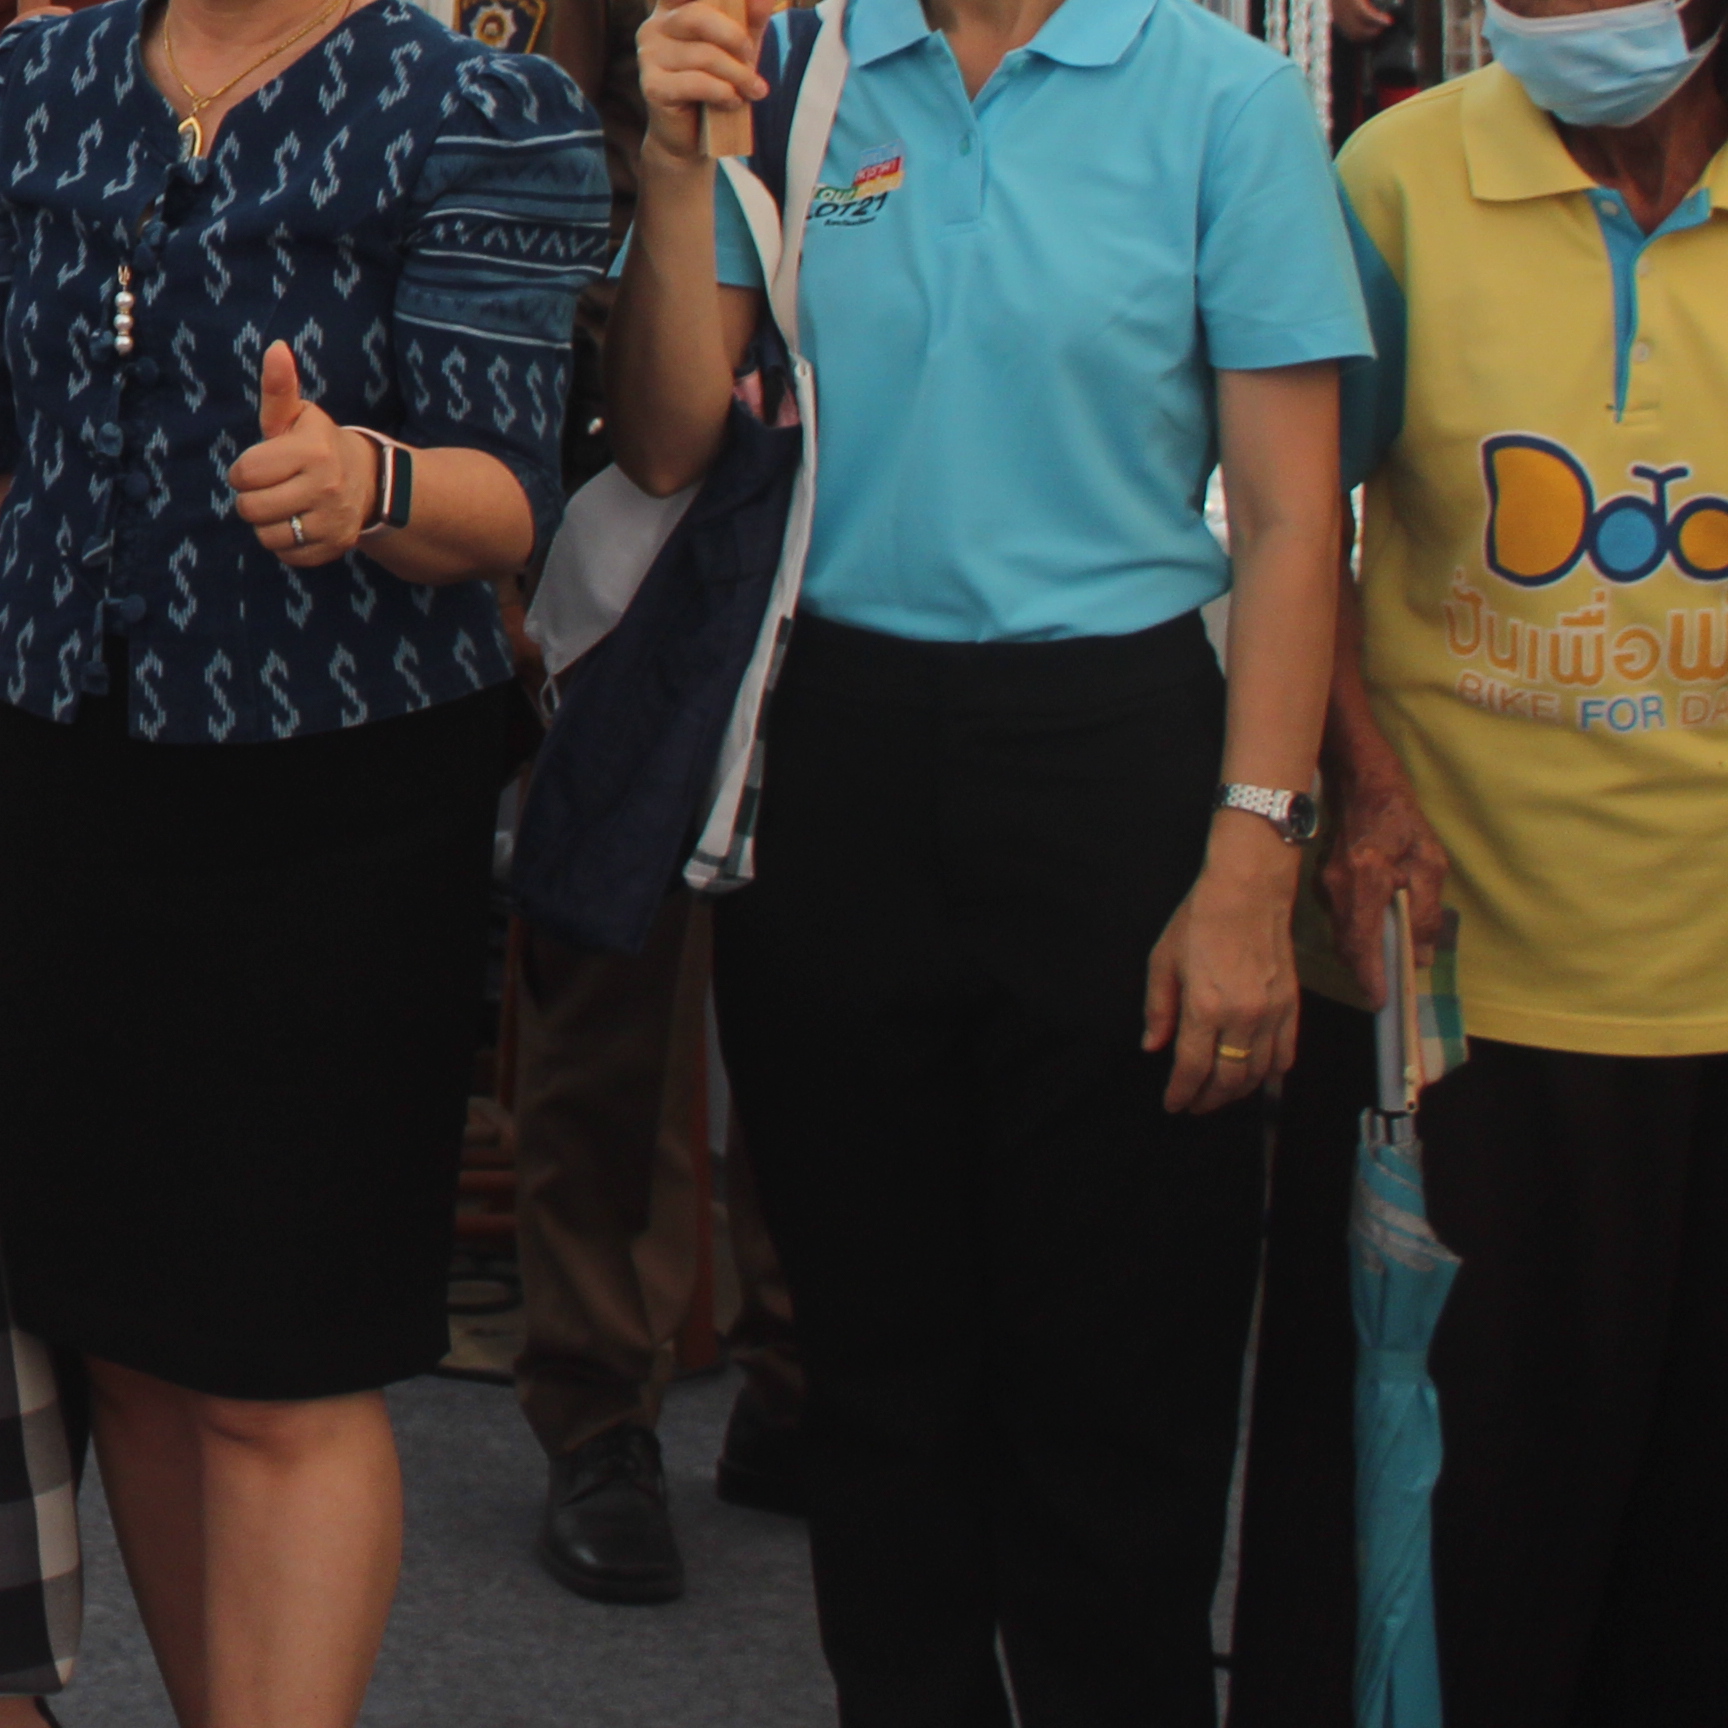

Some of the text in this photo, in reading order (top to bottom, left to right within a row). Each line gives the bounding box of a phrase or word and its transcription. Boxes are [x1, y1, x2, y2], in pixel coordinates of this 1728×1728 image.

[806, 192, 888, 220] OT21
[1444, 568, 1728, 687] ปั่นเพื่อพ
[1456, 672, 1560, 721] BIKE
[1579, 695, 1665, 733] FOR
